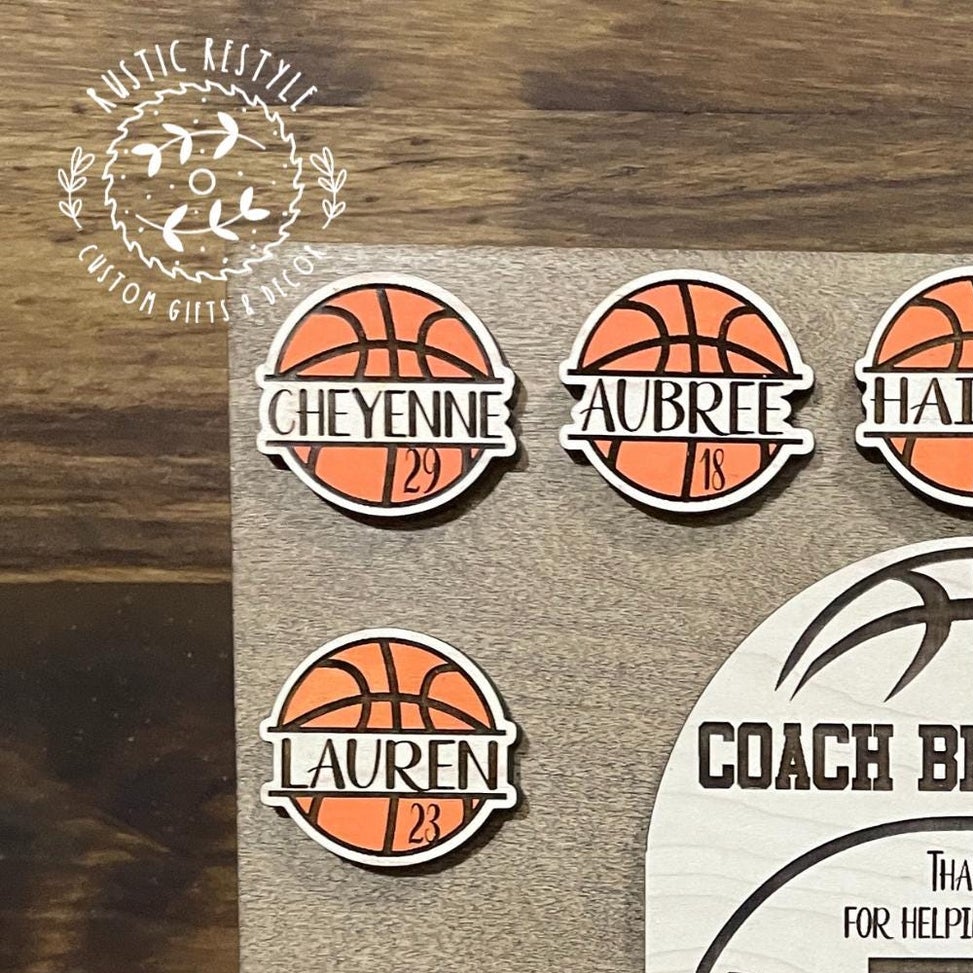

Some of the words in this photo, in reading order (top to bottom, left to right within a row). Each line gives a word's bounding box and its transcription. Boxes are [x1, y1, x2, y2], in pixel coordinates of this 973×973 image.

[269, 388, 502, 439] CHEYENNE
[580, 379, 785, 436] AUBREE
[403, 447, 441, 494] 29
[700, 448, 726, 490] 18
[281, 737, 499, 793] LAUREN
[698, 721, 894, 792] COACH
[408, 802, 442, 843] 23
[844, 906, 893, 941] FOR
